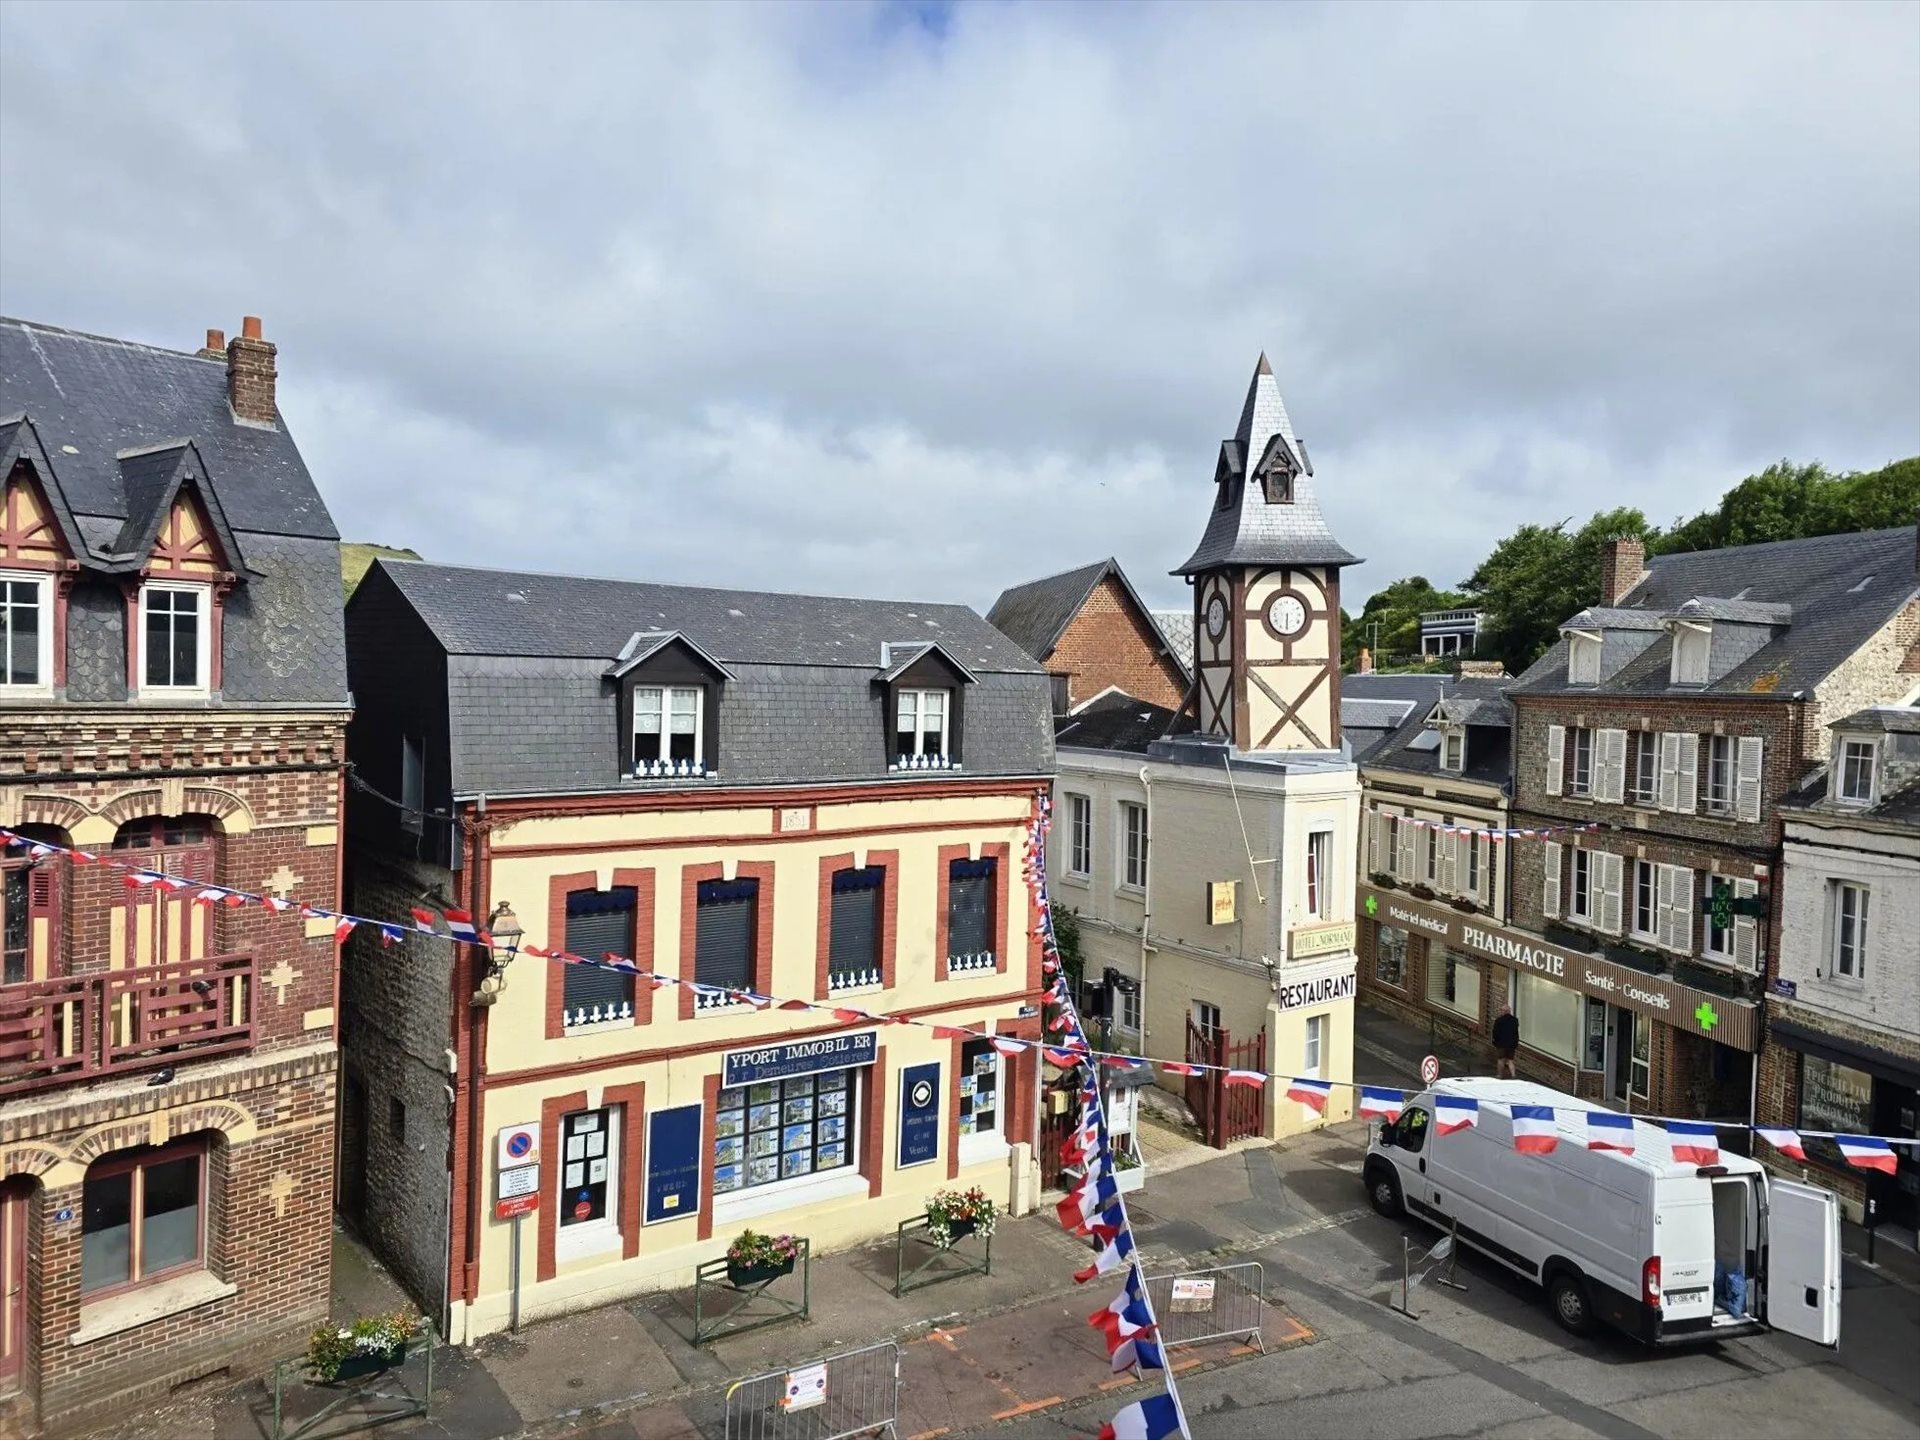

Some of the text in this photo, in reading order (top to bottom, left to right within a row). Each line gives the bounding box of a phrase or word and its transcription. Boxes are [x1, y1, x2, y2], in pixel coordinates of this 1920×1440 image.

[1389, 906, 1448, 935] Matériel médical
[1462, 926, 1564, 977] PHARMACIE
[1280, 974, 1355, 1009] RESTAURANT
[1585, 970, 1614, 991] Santé
[1623, 983, 1670, 1010] Conseils
[730, 1049, 780, 1068] YPORT
